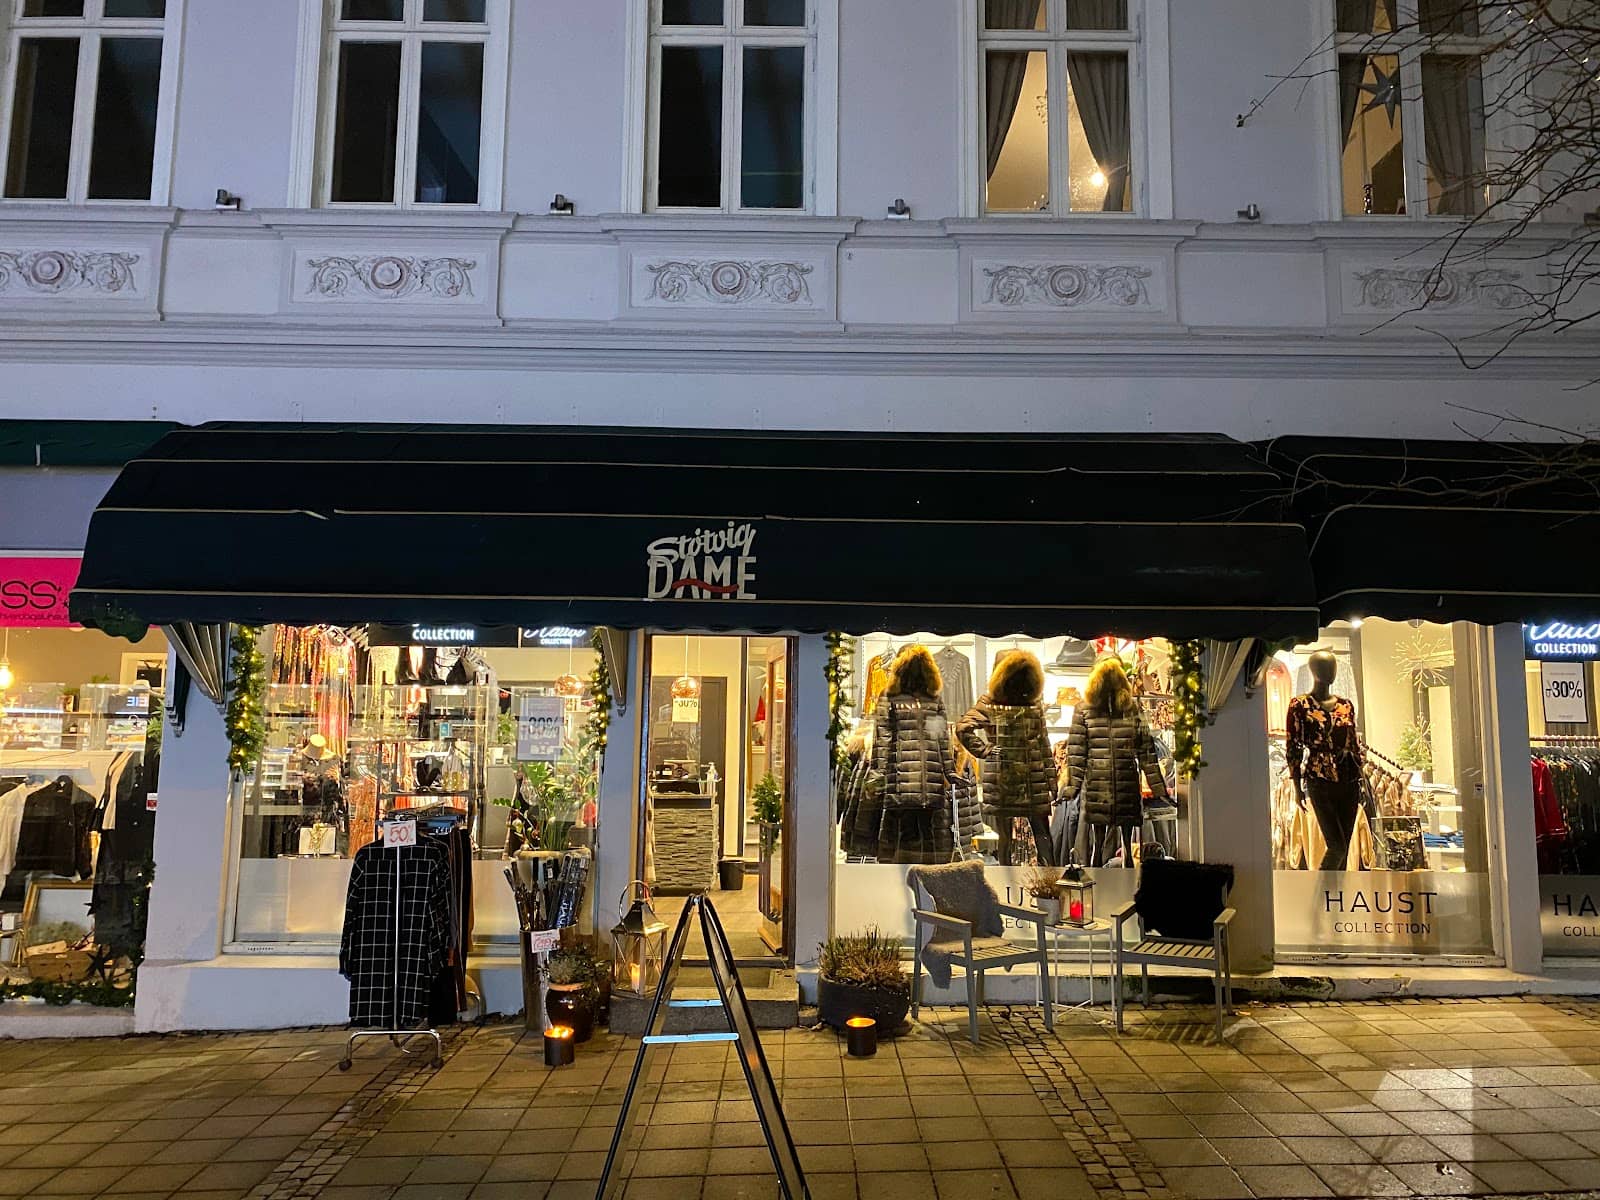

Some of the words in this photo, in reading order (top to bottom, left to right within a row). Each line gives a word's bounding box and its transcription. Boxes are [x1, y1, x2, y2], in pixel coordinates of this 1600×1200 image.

[647, 555, 757, 600] DAME
[412, 628, 475, 641] COLLECTION
[1534, 642, 1597, 654] COLLECTION
[1323, 890, 1438, 914] HAUST
[1334, 921, 1432, 934] COLLECTION
